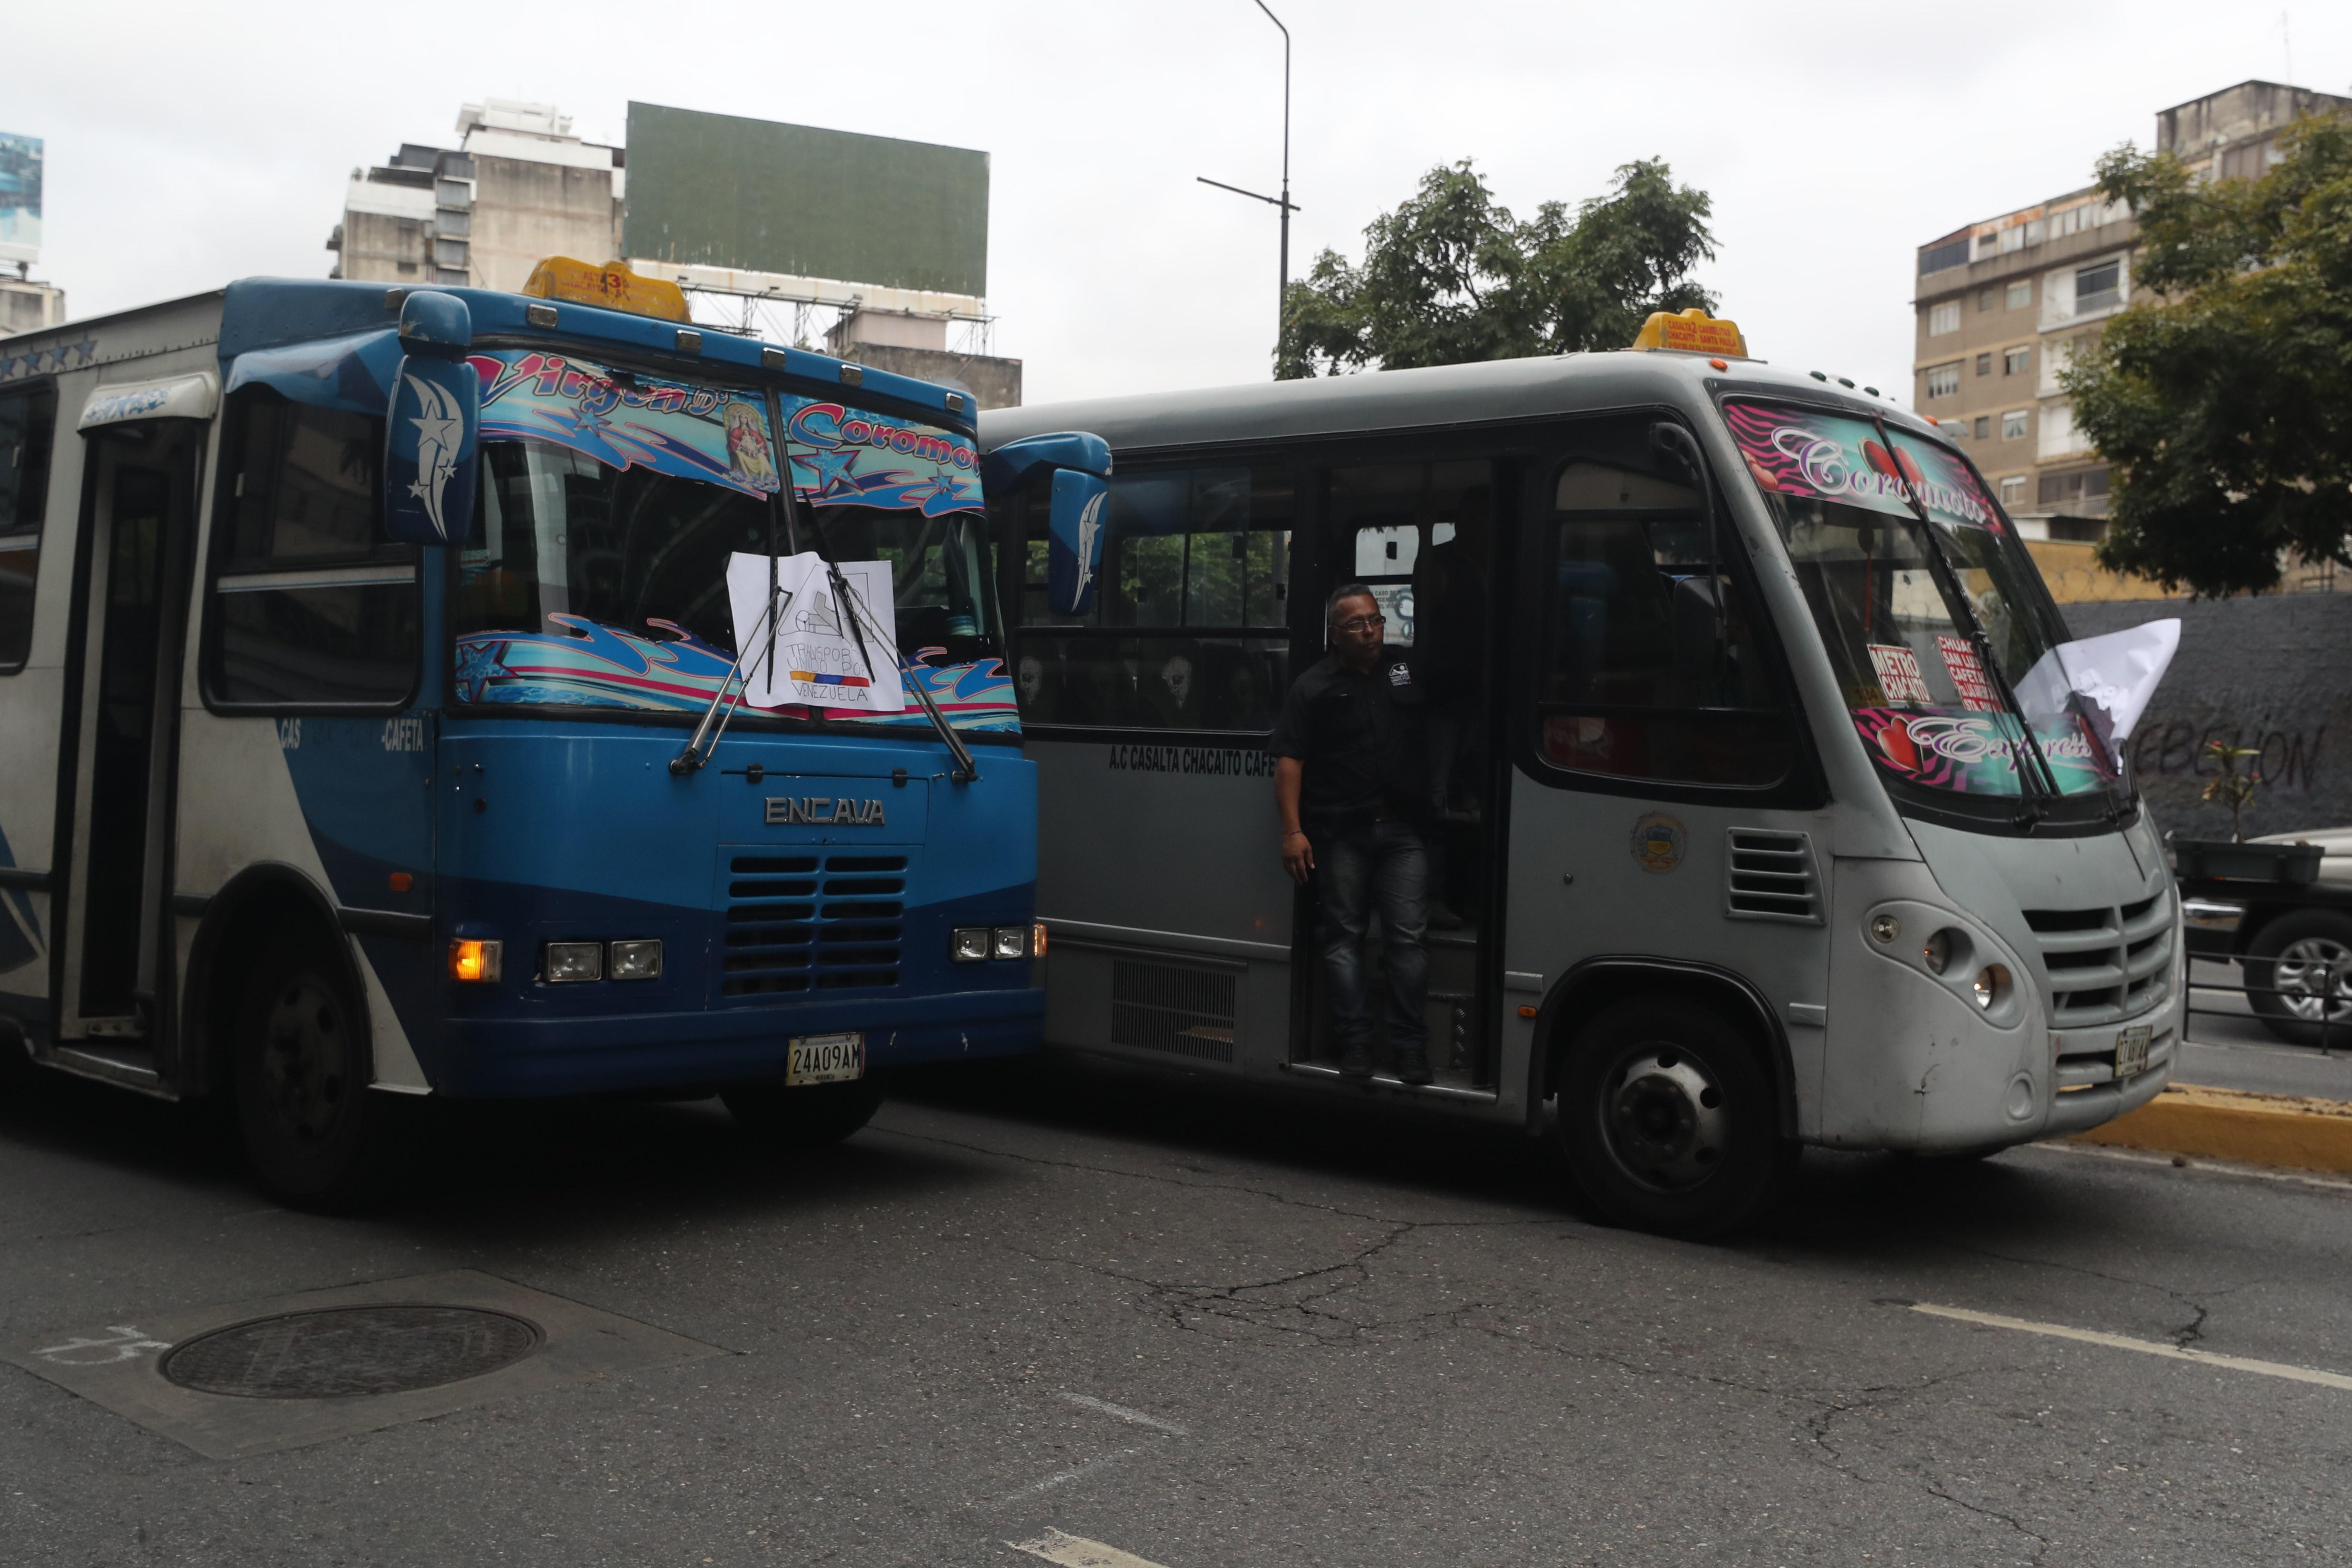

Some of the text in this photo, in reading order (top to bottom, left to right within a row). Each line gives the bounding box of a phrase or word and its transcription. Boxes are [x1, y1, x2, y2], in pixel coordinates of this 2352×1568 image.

[607, 273, 622, 289] 3
[1700, 334, 1718, 345] SANTA
[1719, 337, 1737, 347] PAULA
[1770, 426, 1987, 524] Coromoto
[787, 656, 866, 677] UNIDO POR
[1871, 649, 1920, 678] METRO
[1942, 651, 1963, 666] SAN
[791, 681, 869, 701] VENEZUELA
[1880, 674, 1931, 702] CHACAITO
[281, 717, 301, 750] CAS
[1130, 746, 1179, 772] CASALTA
[1183, 748, 1241, 776] CHACAITO
[764, 796, 885, 826] ENCAVA
[793, 1043, 861, 1074] 24A09AM
